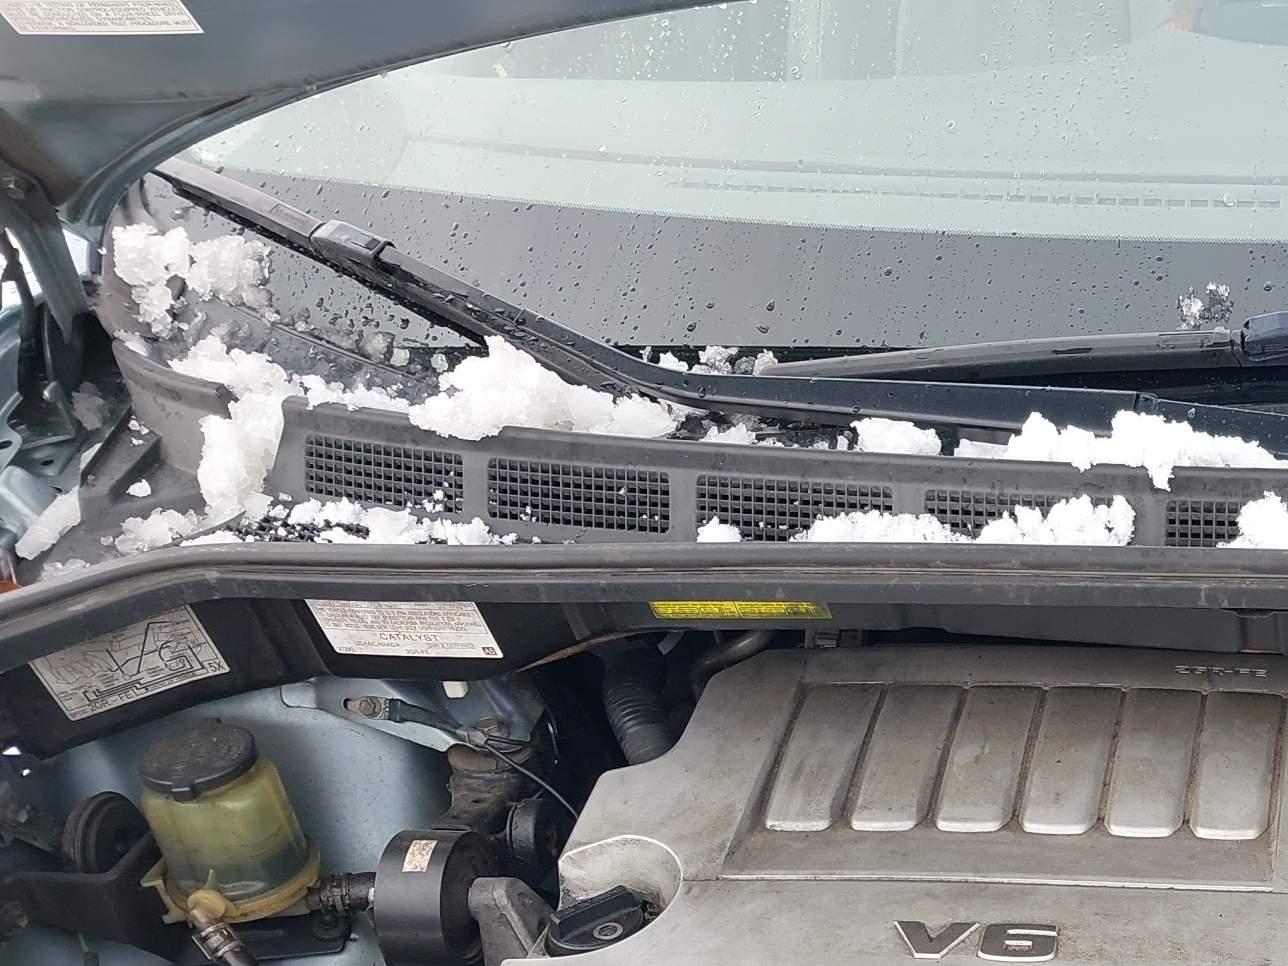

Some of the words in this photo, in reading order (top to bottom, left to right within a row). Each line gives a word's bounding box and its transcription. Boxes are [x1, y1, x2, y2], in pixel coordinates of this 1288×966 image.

[379, 632, 440, 641] CATALYST
[208, 660, 226, 673] 5X
[894, 920, 1058, 963] V6
